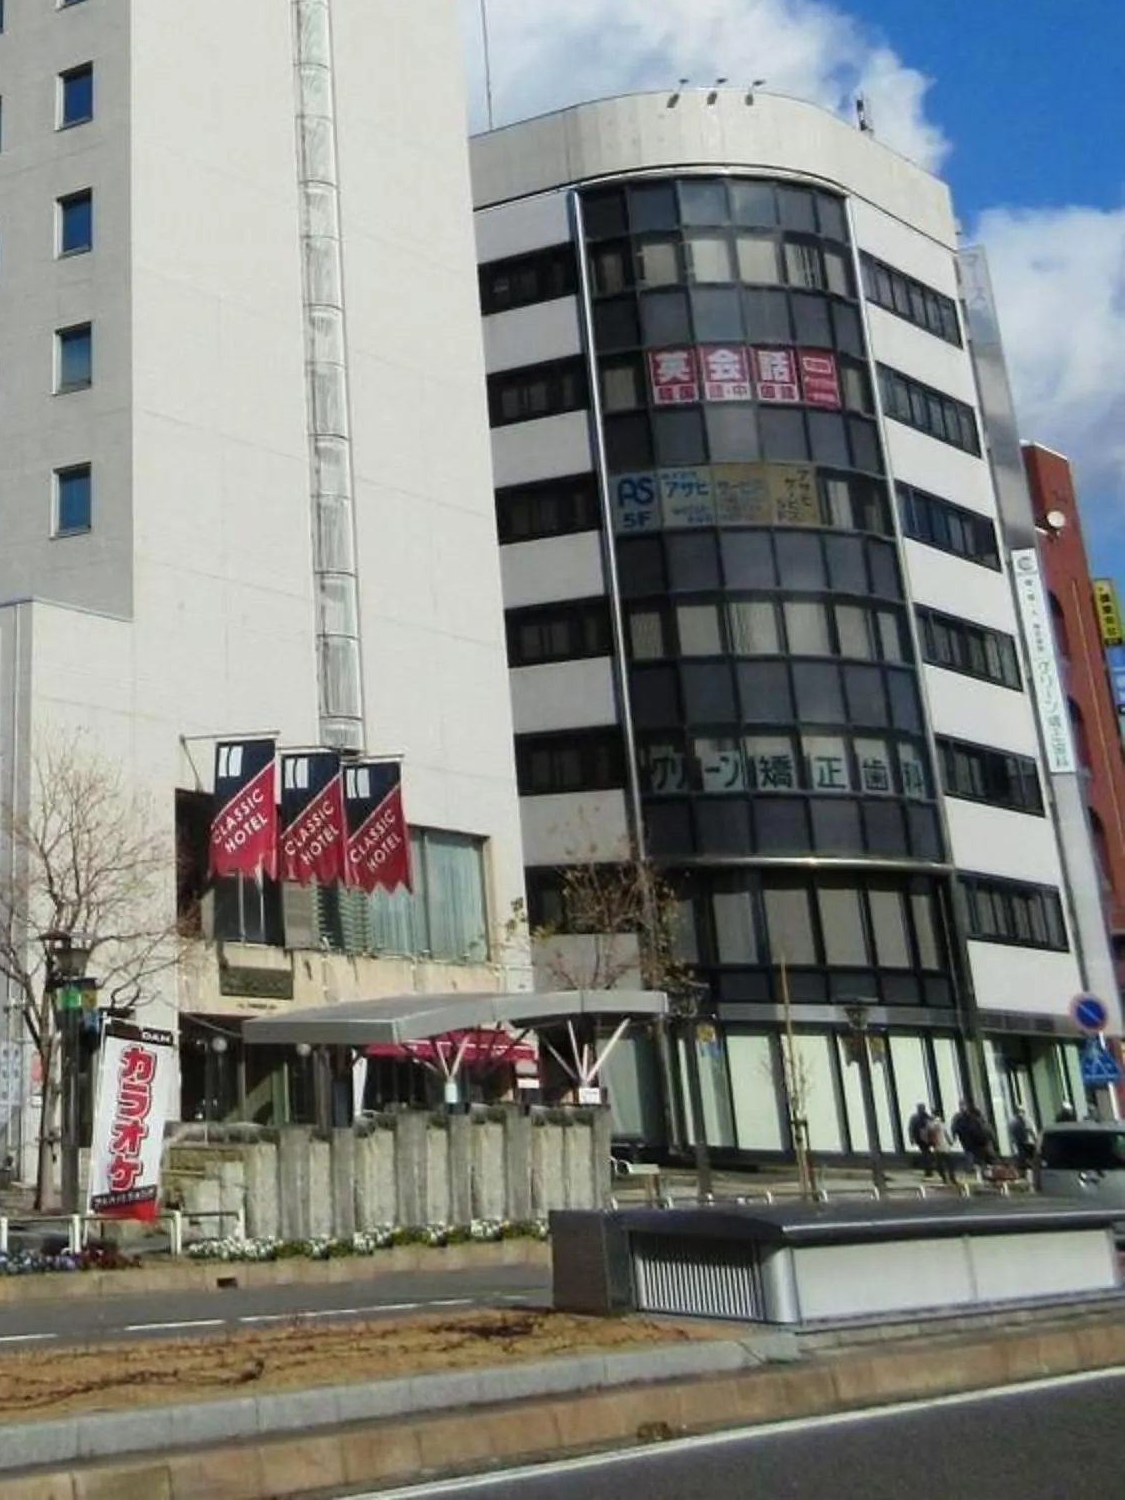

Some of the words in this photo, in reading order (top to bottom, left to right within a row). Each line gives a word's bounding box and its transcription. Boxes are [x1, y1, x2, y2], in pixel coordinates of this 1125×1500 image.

[654, 349, 793, 383] 英会話
[652, 753, 925, 794] クリーン矯正歯科
[213, 788, 265, 845] CLASSIC
[225, 812, 268, 854] HOTEL
[284, 800, 335, 856] CLASSIC
[348, 808, 396, 863] CLASSIC
[299, 823, 340, 866] HOTEL
[366, 831, 402, 872] HOTEL
[108, 1044, 158, 1193] カラオケ
